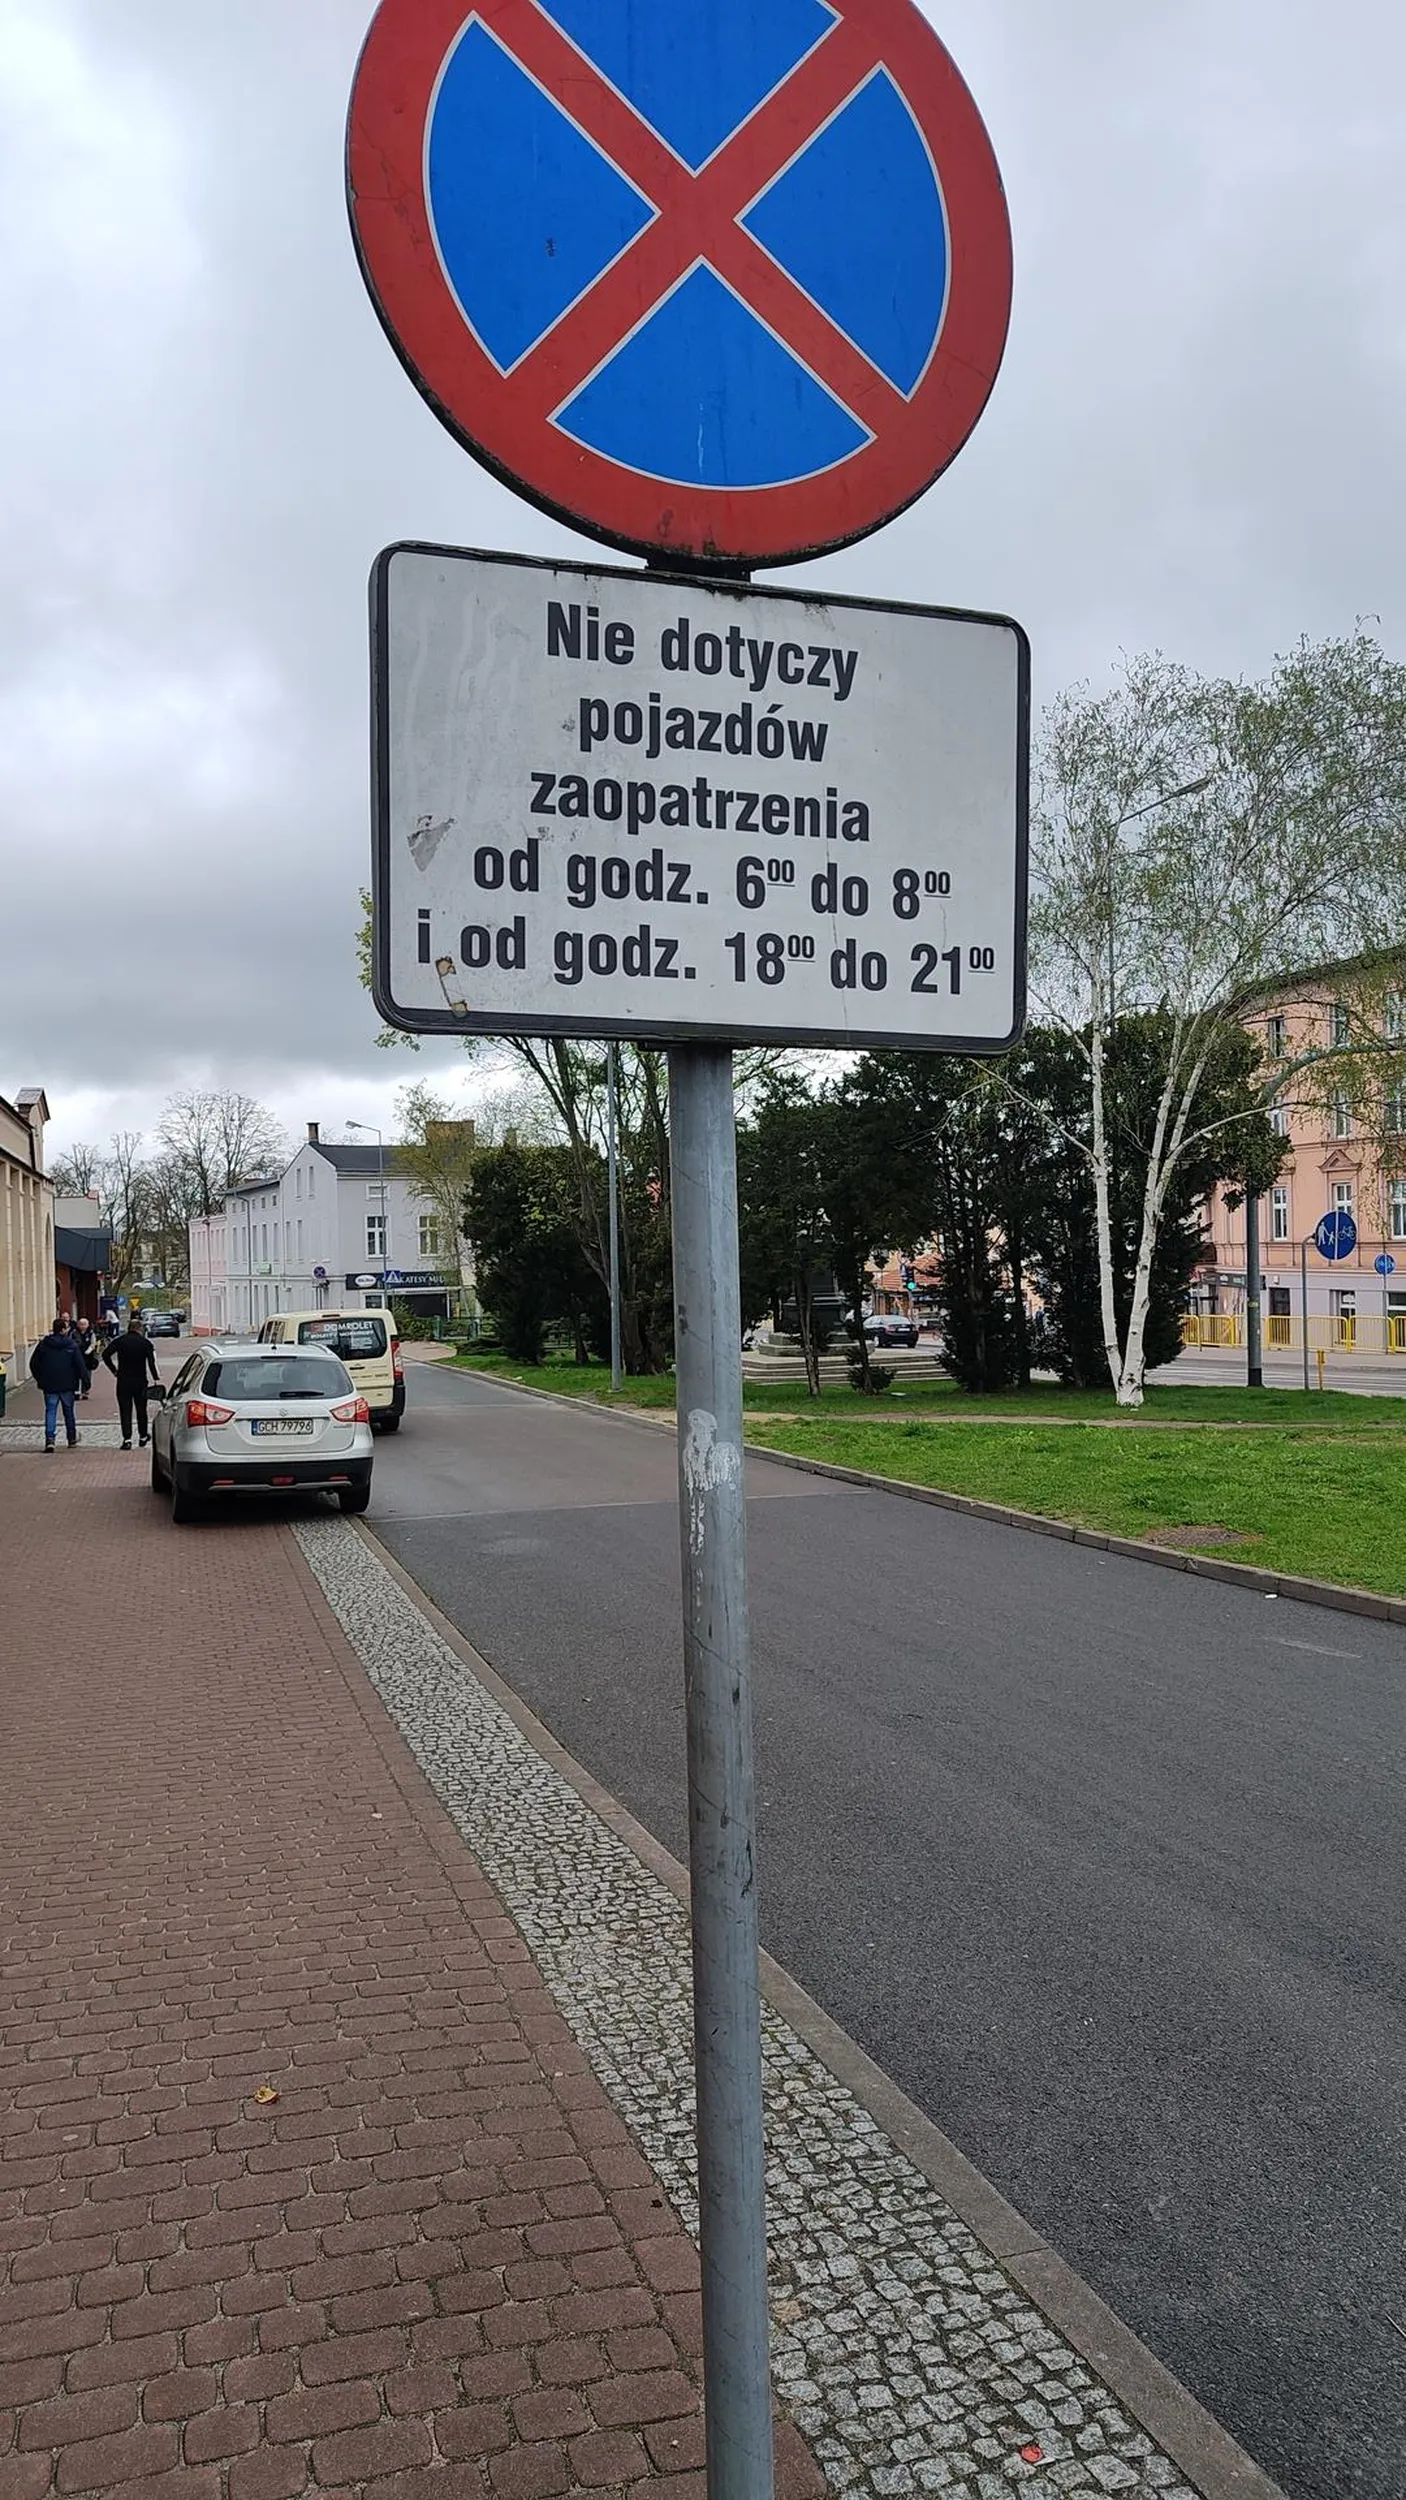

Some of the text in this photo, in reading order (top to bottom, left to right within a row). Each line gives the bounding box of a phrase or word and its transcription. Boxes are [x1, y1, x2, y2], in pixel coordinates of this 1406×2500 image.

[547, 601, 859, 702] Nie dotyczy
[579, 692, 829, 763] pojazdów
[530, 771, 870, 842] zaopatrzenia
[474, 837, 539, 893] od
[566, 848, 709, 910] godz.
[812, 862, 869, 917] do
[417, 908, 431, 965] i
[461, 916, 527, 970] od
[553, 924, 697, 986] godz.
[831, 938, 888, 992] do
[259, 1421, 312, 1432] GCH 79796
